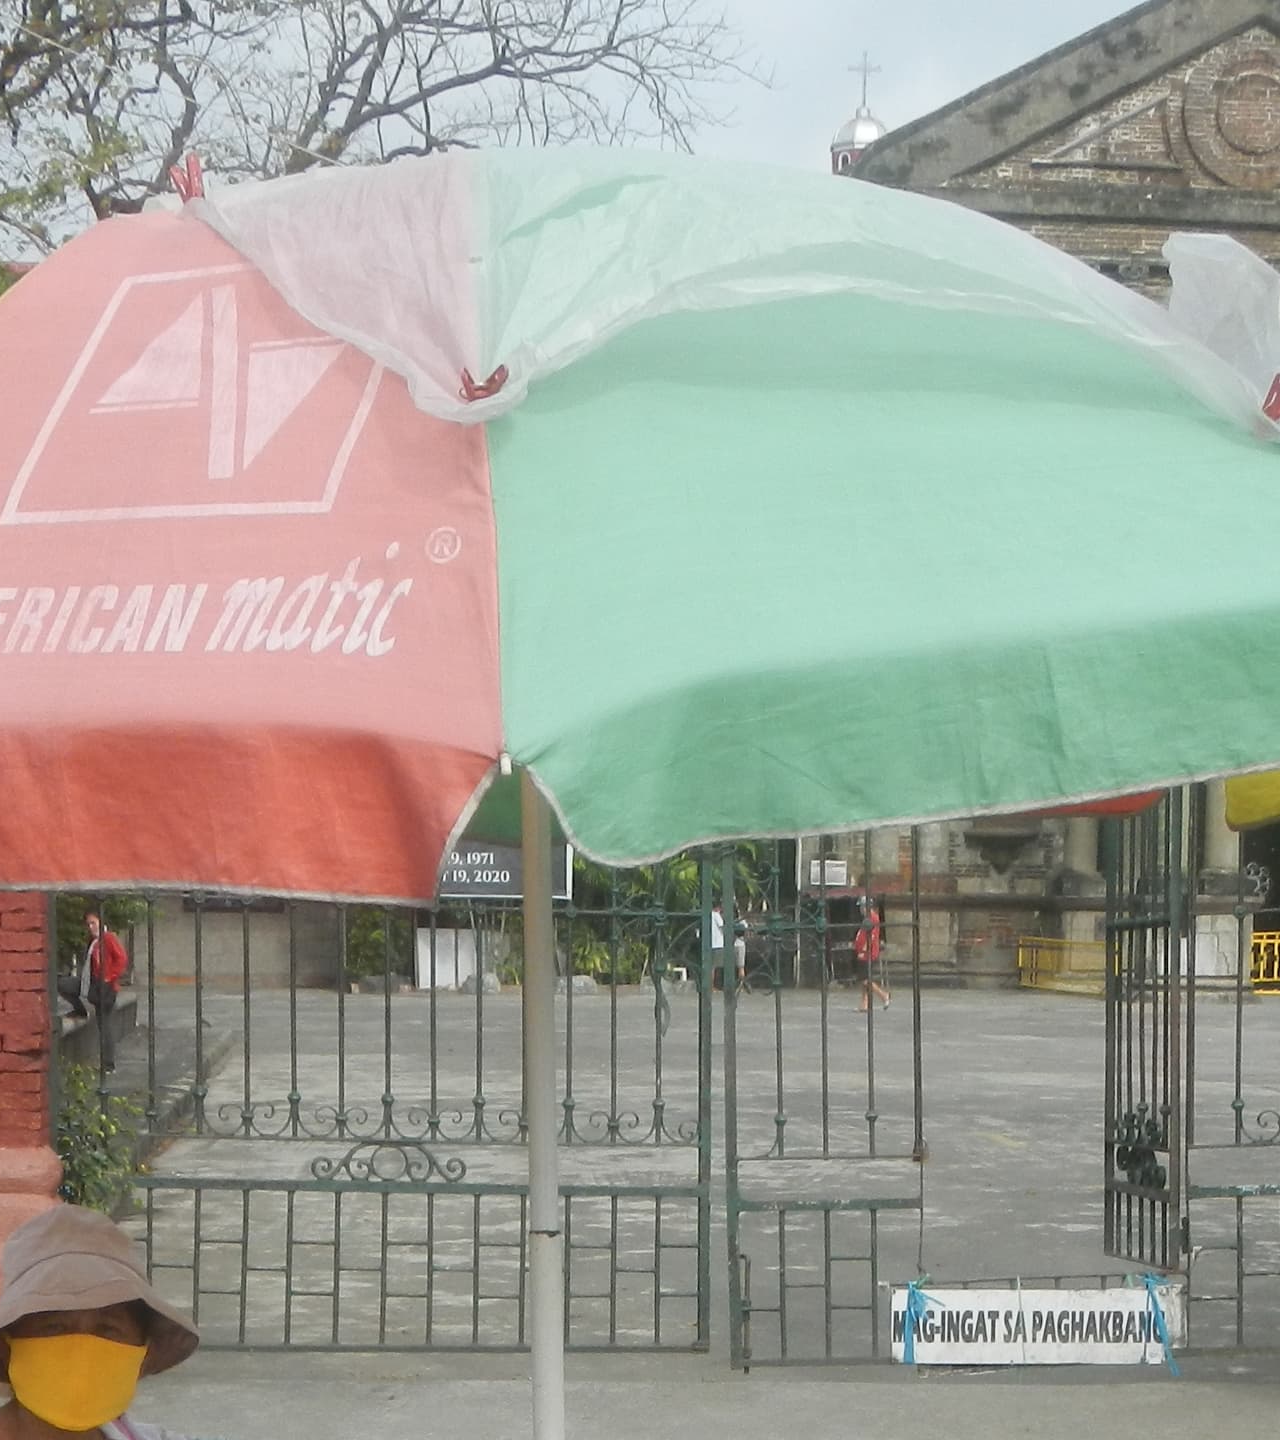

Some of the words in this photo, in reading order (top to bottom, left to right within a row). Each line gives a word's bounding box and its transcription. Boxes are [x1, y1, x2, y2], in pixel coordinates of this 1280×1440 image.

[204, 541, 414, 656] matic
[466, 851, 494, 865] 1971
[452, 869, 470, 884] 19,
[473, 869, 510, 883] 2020
[1003, 1310, 1028, 1343] SA
